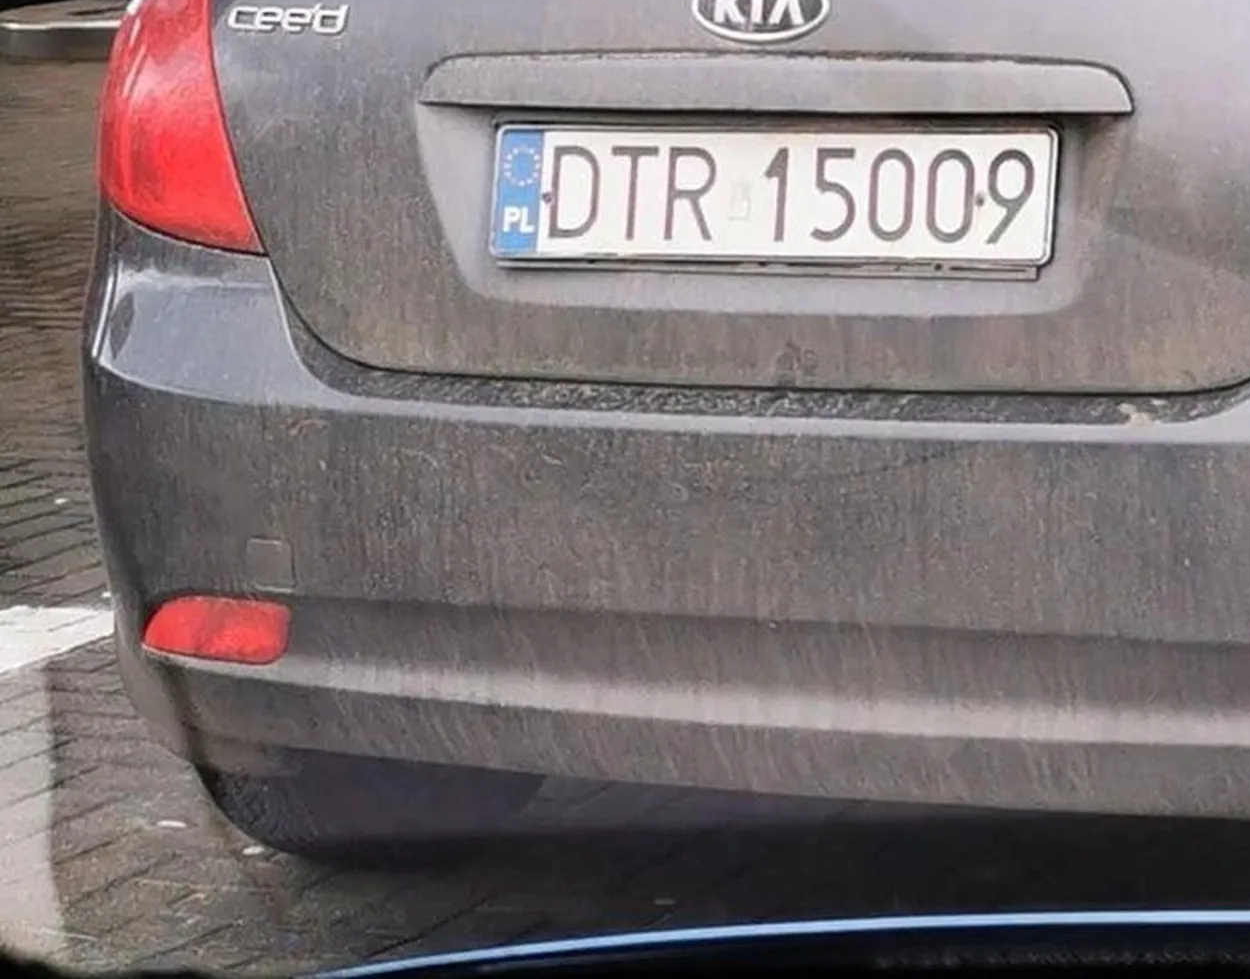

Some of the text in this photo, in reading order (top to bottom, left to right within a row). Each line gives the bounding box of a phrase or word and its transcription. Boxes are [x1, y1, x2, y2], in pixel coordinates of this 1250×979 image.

[503, 206, 535, 233] PL
[547, 145, 1035, 244] DTR 15009
